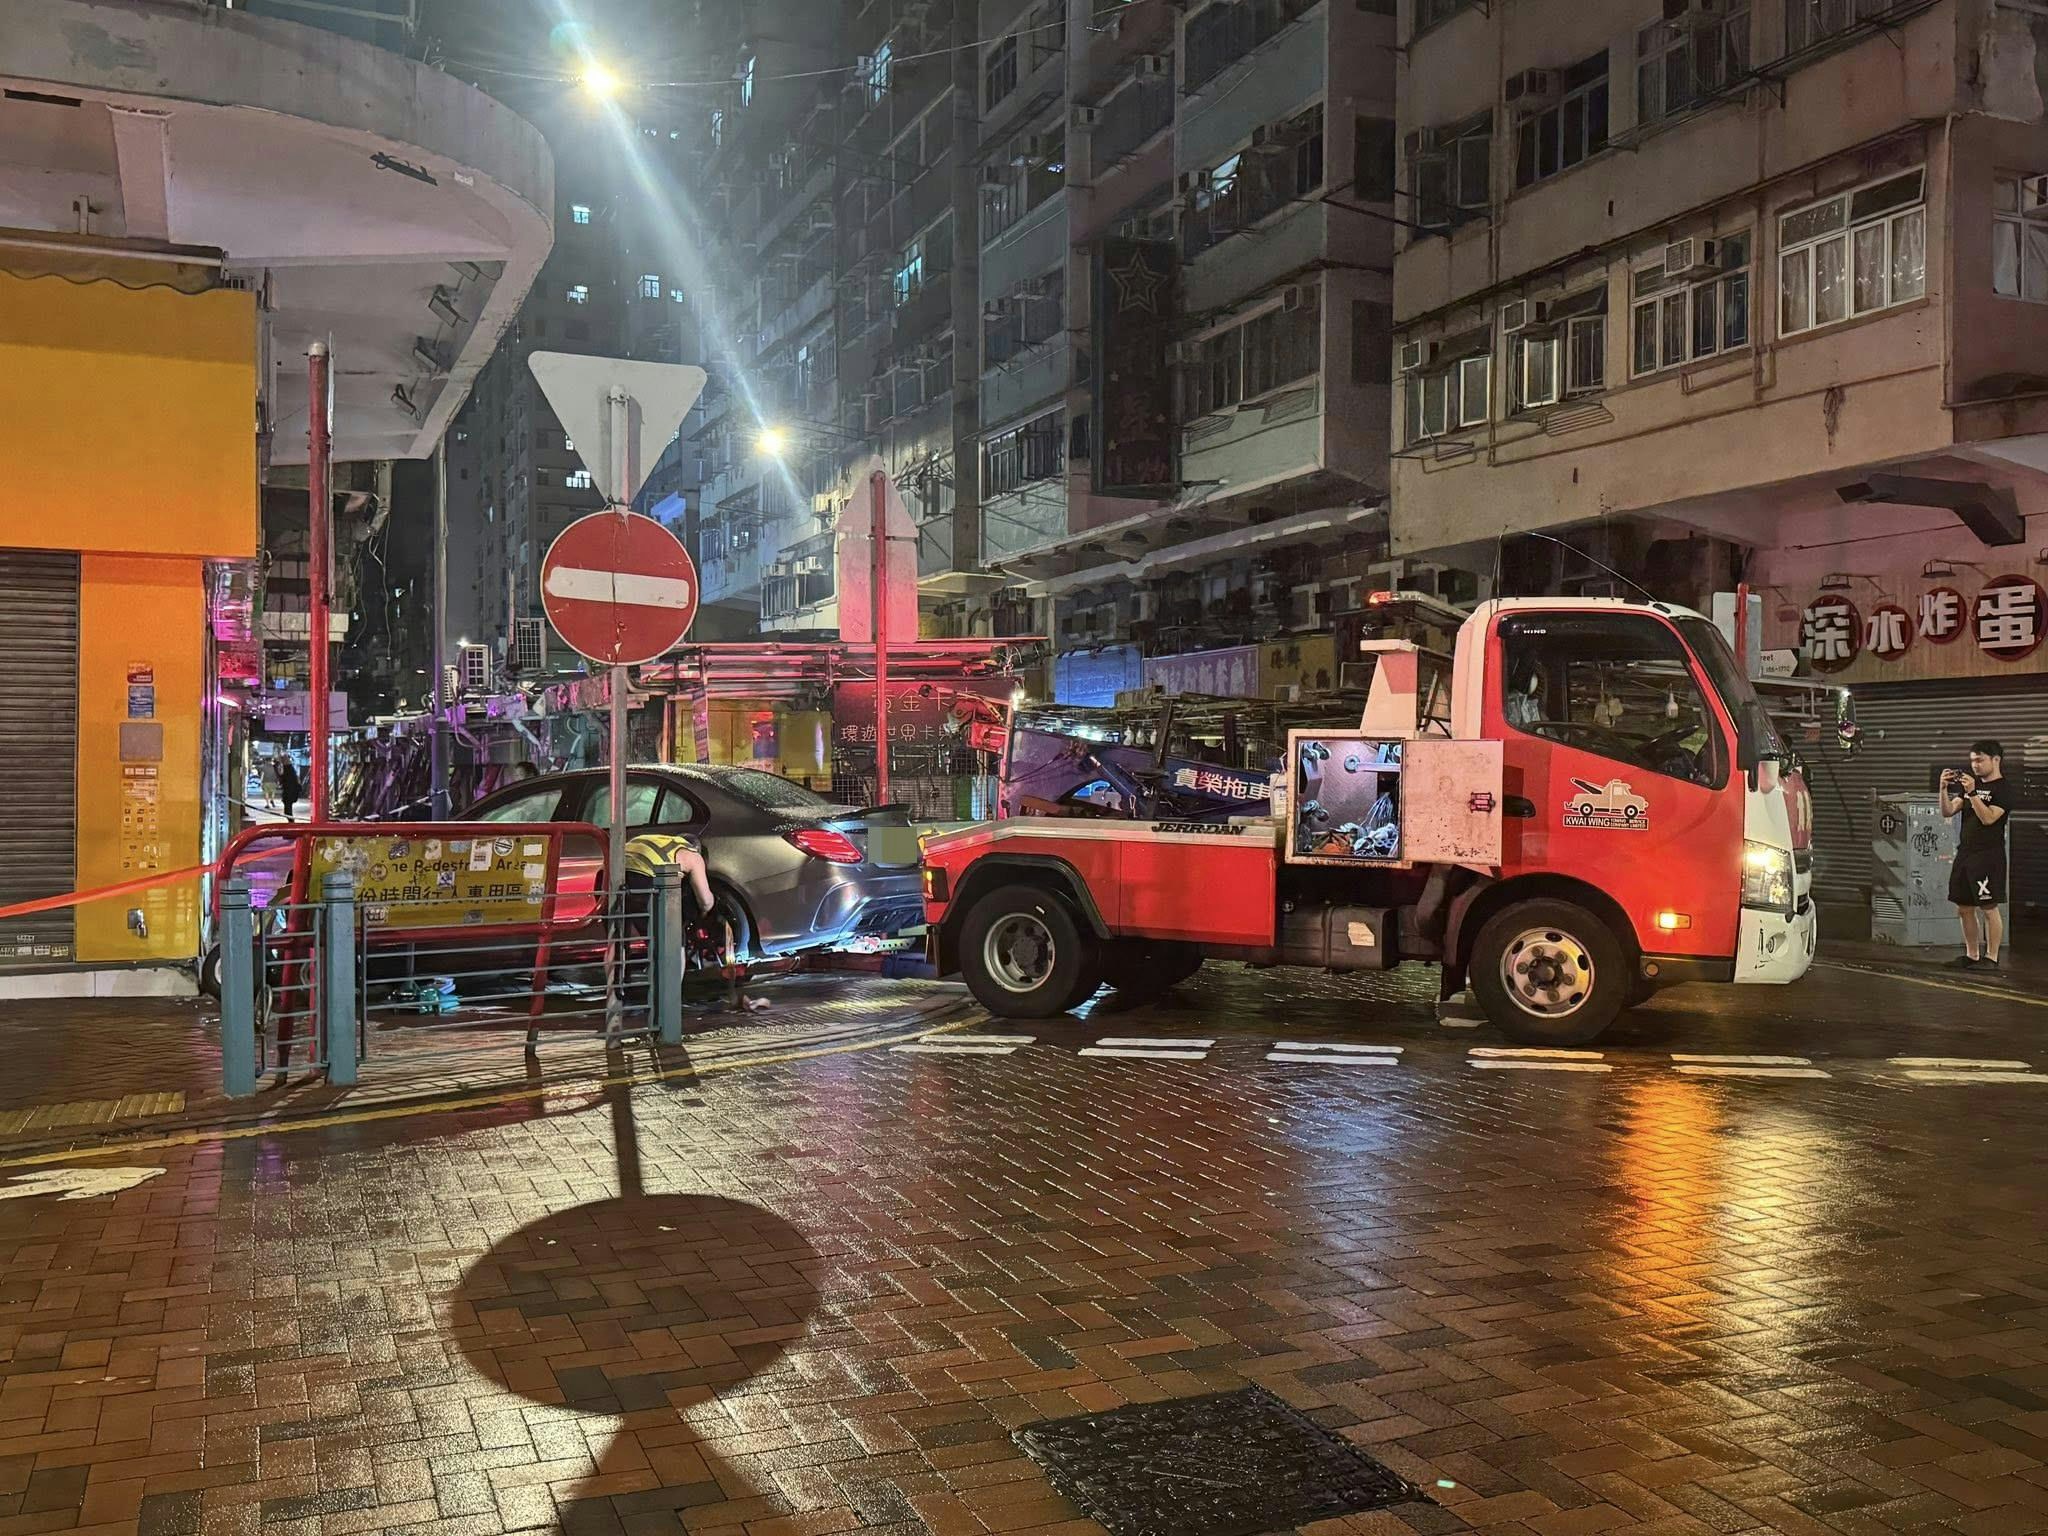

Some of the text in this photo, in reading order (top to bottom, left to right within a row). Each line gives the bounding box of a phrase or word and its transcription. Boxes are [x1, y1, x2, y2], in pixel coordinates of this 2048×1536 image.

[1803, 583, 2036, 661] 深水炸蛋
[1173, 767, 1271, 800] 貴榮拖車
[1565, 816, 1610, 827] KWAI WING
